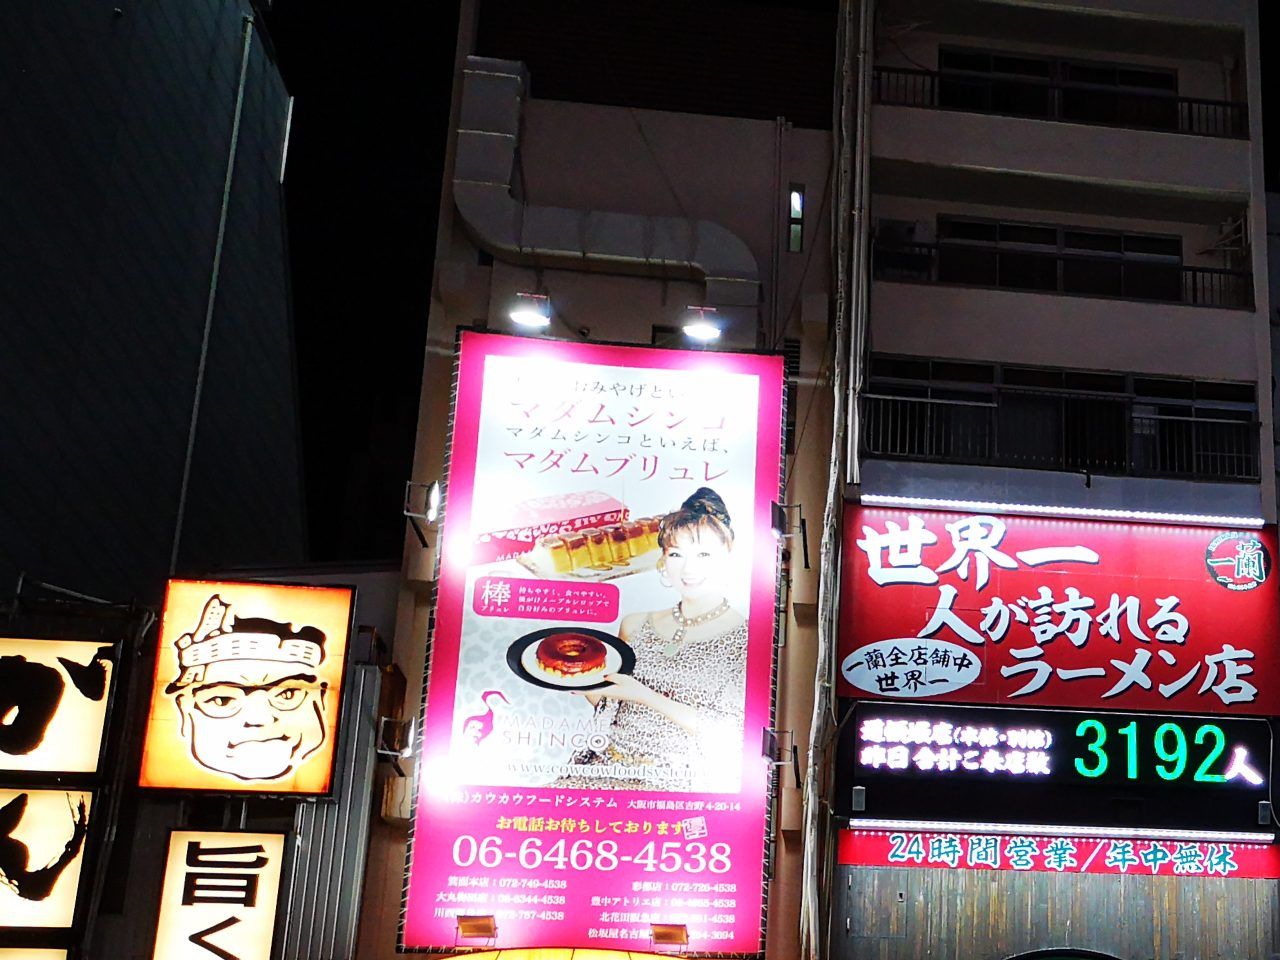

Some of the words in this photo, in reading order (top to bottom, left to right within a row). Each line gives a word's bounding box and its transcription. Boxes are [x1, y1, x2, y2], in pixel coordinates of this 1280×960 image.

[503, 449, 729, 481] マダムブリュレ
[857, 515, 1099, 591] 世界一
[481, 580, 511, 606] 棒
[917, 584, 1190, 647] 人が訪れる
[847, 646, 974, 670] 一蘭全店舗中
[875, 672, 950, 695] 世界一
[1000, 643, 1258, 706] ラーメン店
[503, 732, 610, 751] SHINCO
[496, 815, 684, 835] お電話お待ちしております
[452, 834, 731, 873] 06-6468-4538
